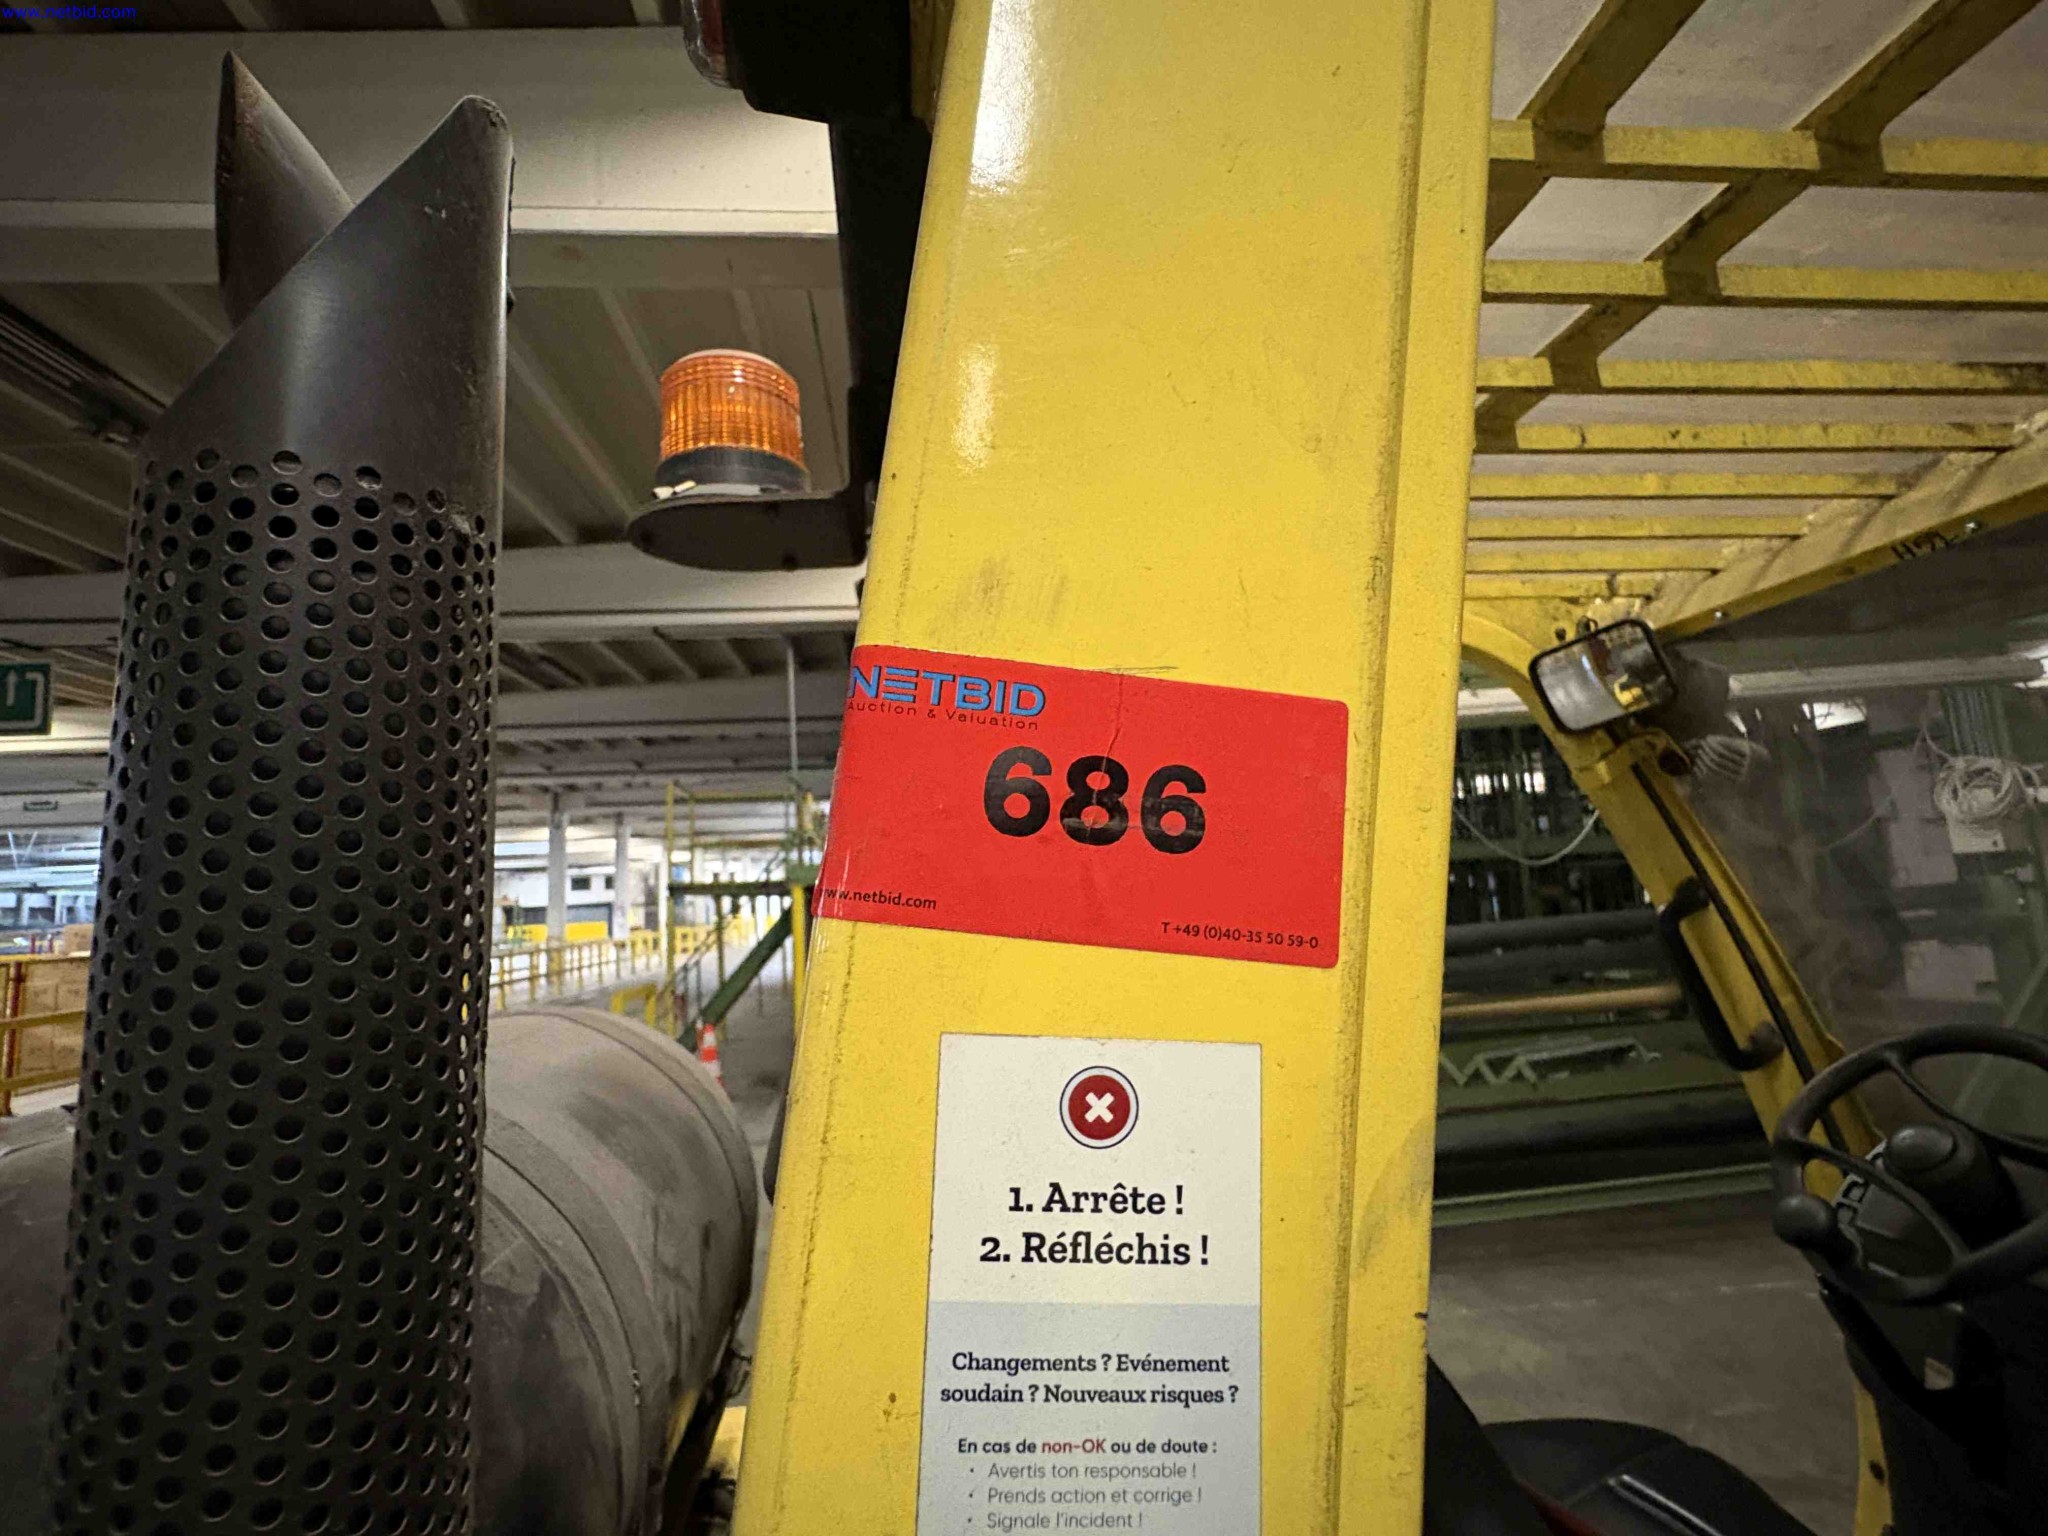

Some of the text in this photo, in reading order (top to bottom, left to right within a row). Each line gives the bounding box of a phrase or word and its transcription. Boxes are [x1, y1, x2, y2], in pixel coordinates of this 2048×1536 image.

[848, 665, 1046, 717] NETBID
[847, 701, 1038, 731] Auction & Valuation
[983, 745, 1207, 855] 686
[1161, 922, 1319, 949] T +49 (0)40-35 50 59-0
[1008, 1182, 1184, 1215] 1. Arrête !
[979, 1230, 1208, 1266] 2. Réfléchis !
[951, 1352, 1230, 1376] Changements ? Evénement
[940, 1383, 1239, 1408] soudain ? Nouveaux risques ?
[958, 1438, 978, 1453] En
[982, 1442, 1011, 1453] cas
[1015, 1437, 1037, 1453] de
[1041, 1438, 1107, 1454] non-OK
[1110, 1442, 1131, 1454] ou
[1135, 1438, 1157, 1454] de
[1161, 1438, 1209, 1454] doute
[987, 1462, 1046, 1478] Avertis
[1051, 1465, 1078, 1478] ton
[1084, 1462, 1187, 1481] responsable
[987, 1486, 1046, 1503] Prends
[1051, 1486, 1106, 1503] action
[1110, 1489, 1128, 1503] et
[1133, 1486, 1193, 1507] corrige
[987, 1511, 1051, 1533] Signale
[1056, 1511, 1133, 1529] l'incident
